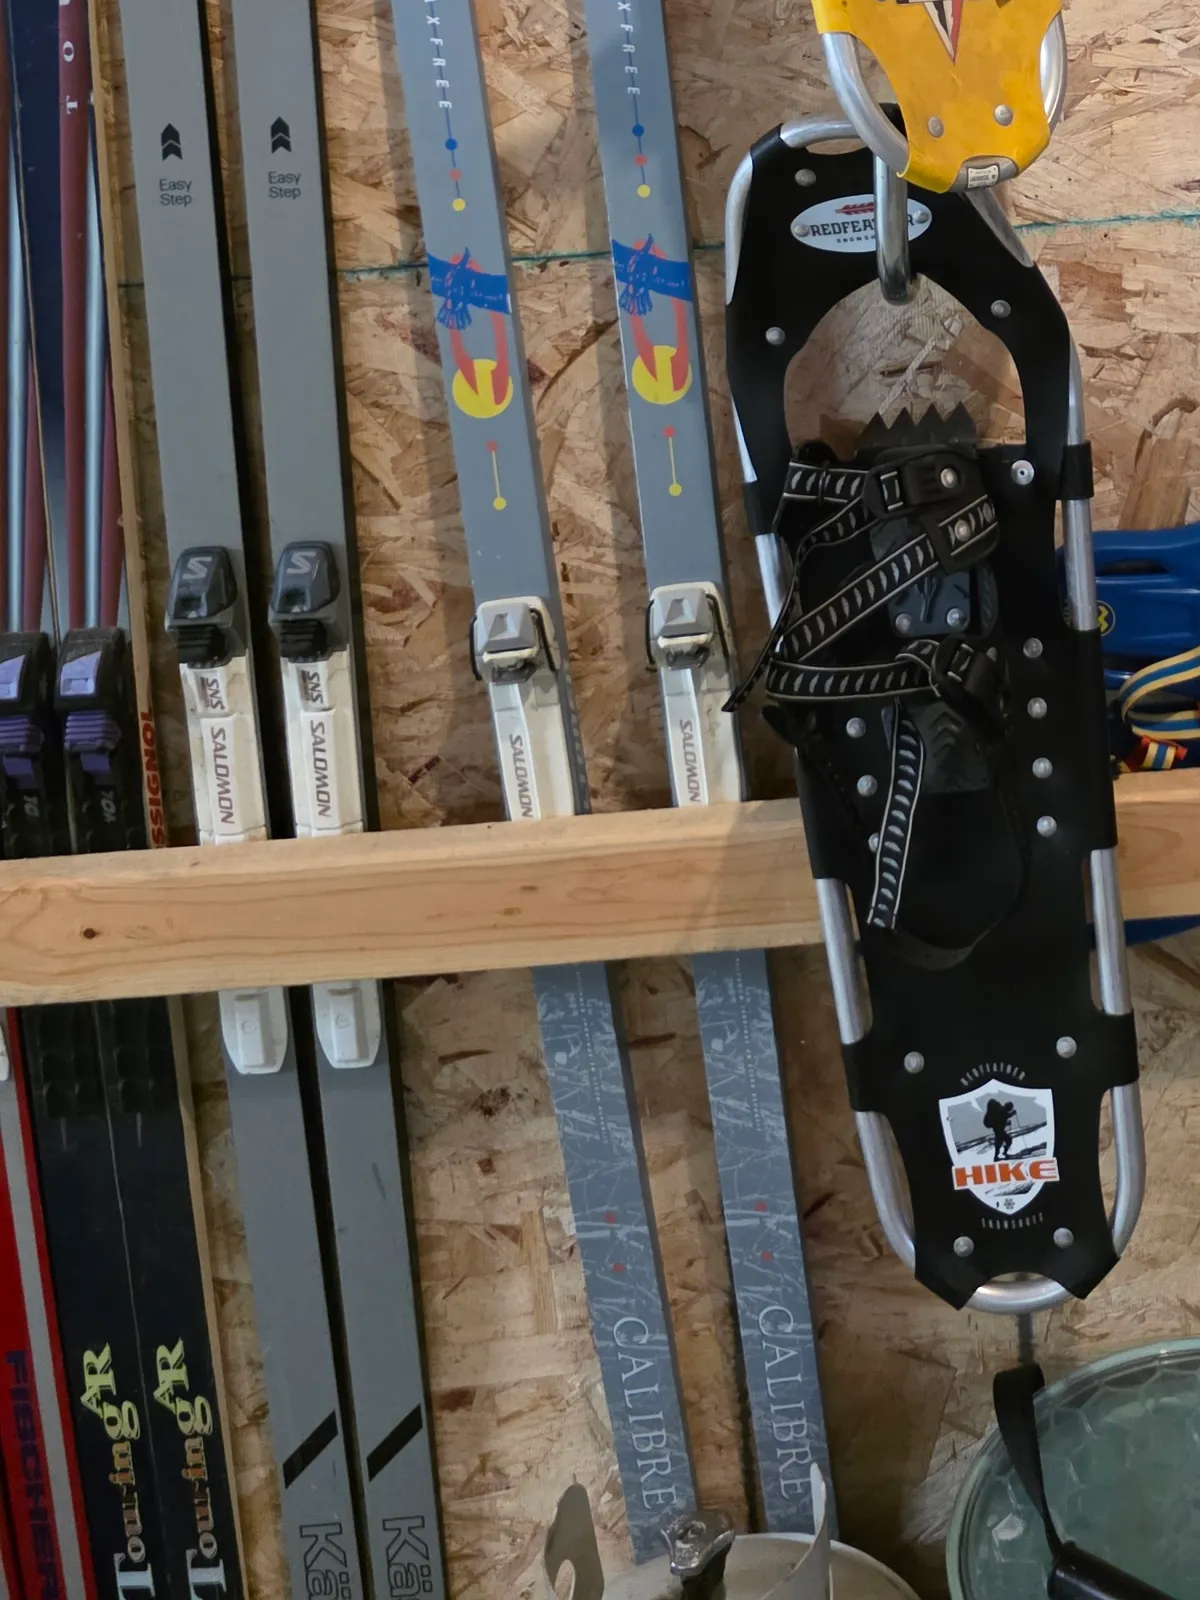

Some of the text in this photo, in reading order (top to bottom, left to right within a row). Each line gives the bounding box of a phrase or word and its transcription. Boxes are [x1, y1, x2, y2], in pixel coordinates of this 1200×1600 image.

[159, 178, 192, 193] Easy
[160, 193, 192, 207] Step
[268, 171, 301, 185] Easy
[268, 186, 301, 200] Step
[809, 214, 915, 237] REDFEAR
[204, 677, 225, 711] SNS
[304, 670, 324, 705] SNS
[140, 711, 165, 848] SSIGNOL
[211, 726, 235, 825] SALOMON
[310, 719, 332, 818] SALOMON
[509, 733, 535, 818] SALOMON
[678, 718, 701, 802] SALOMON
[955, 1159, 1058, 1188] HIKE
[613, 1316, 678, 1509] CALIBRE
[758, 1305, 812, 1500] CALIBRE
[6, 1350, 58, 1600] FISCHER
[109, 1400, 156, 1600] Touring
[181, 1395, 227, 1600] Touring
